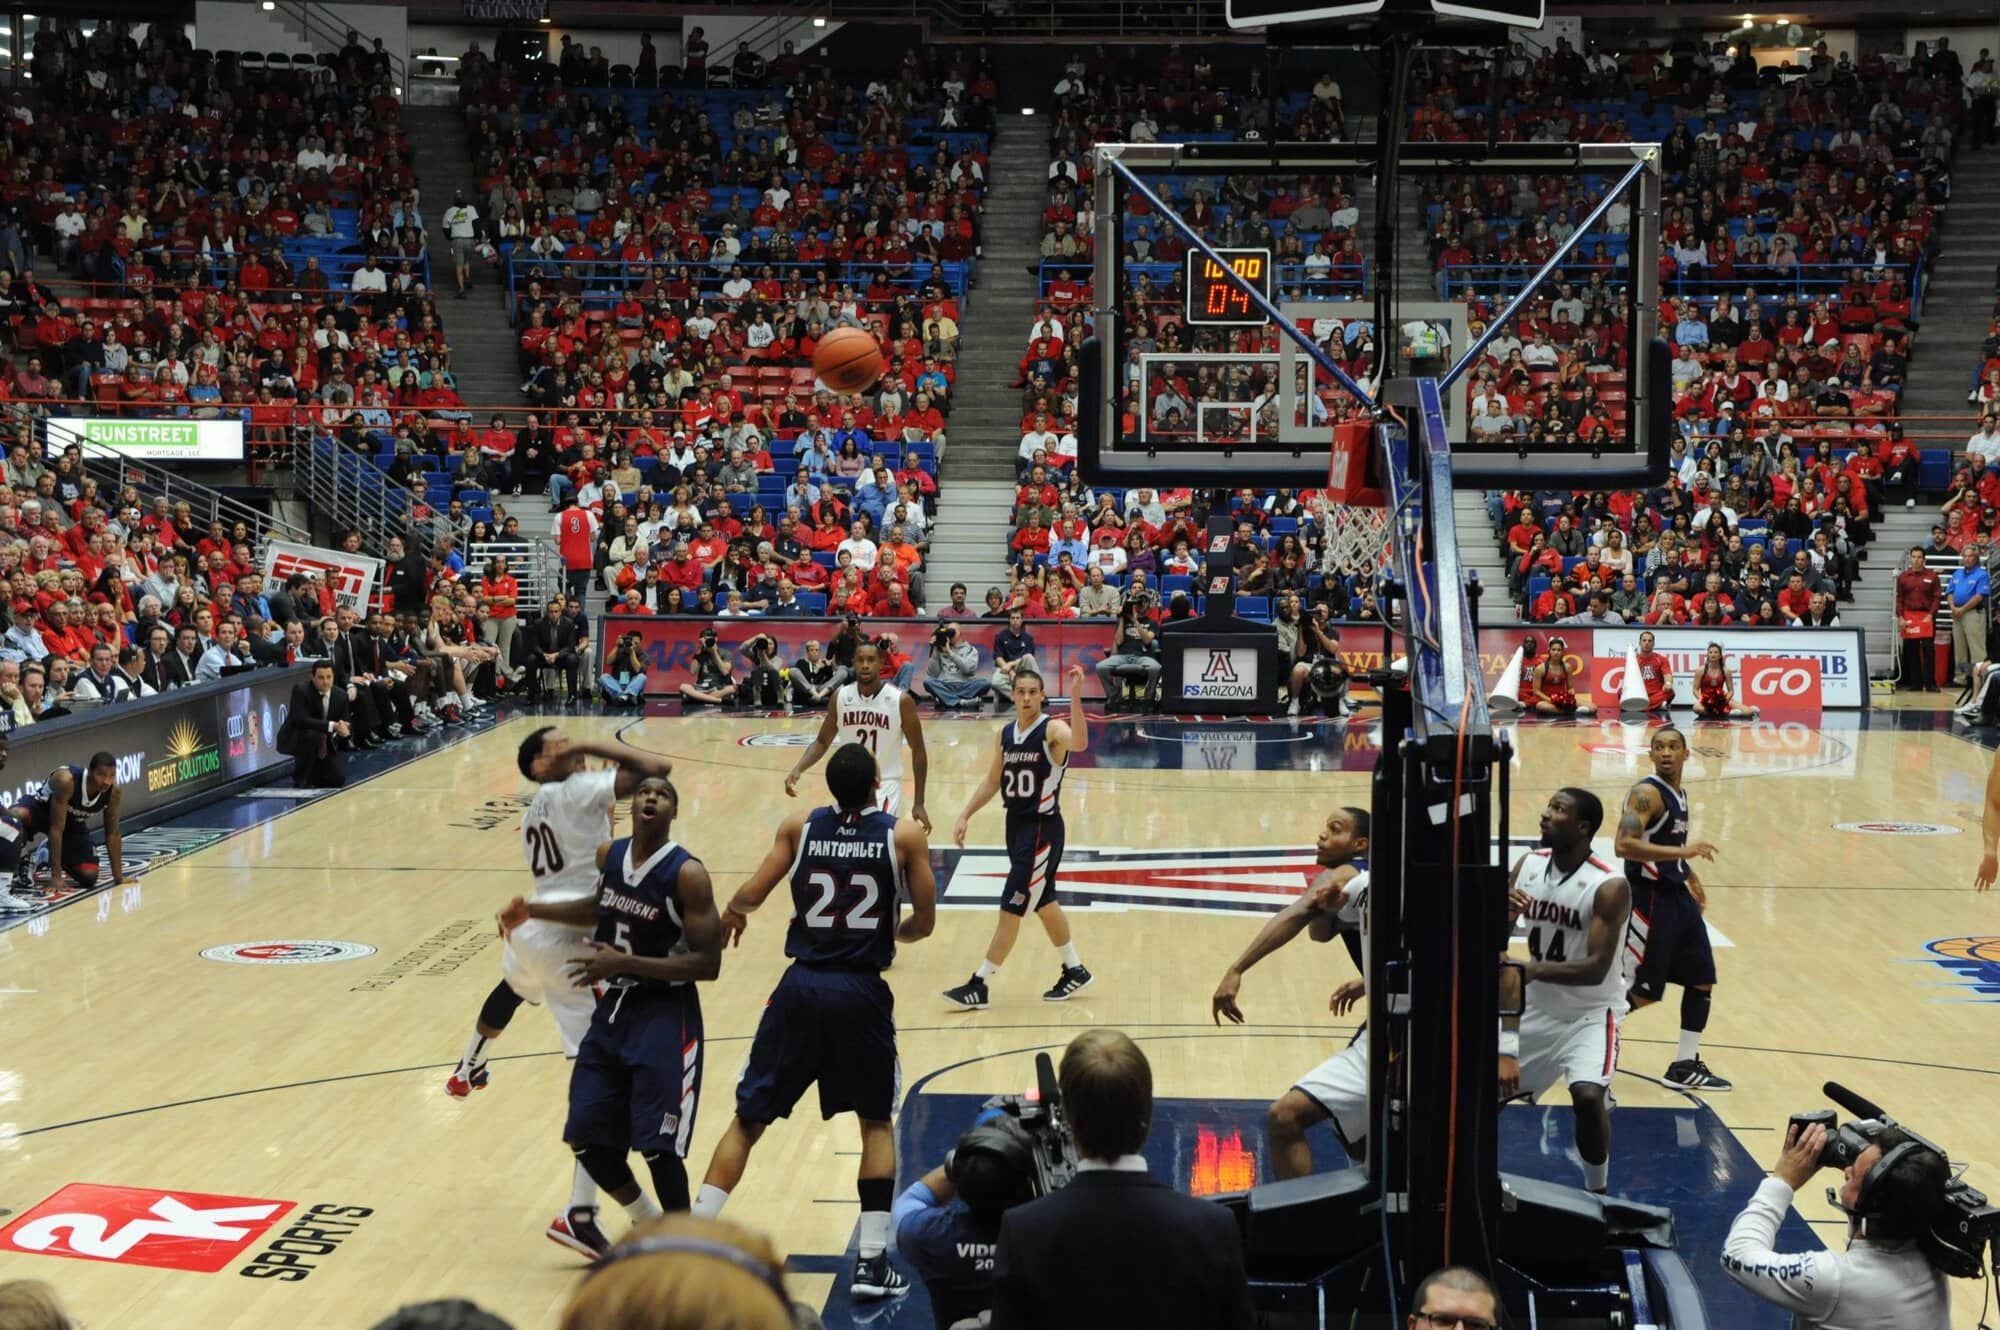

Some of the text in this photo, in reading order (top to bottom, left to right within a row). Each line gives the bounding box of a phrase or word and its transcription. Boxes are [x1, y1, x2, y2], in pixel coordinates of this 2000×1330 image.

[91, 427, 193, 442] SUNSTREET
[571, 518, 581, 533] 3
[336, 594, 358, 607] SPORTS
[1751, 667, 1811, 696] GO
[843, 710, 890, 730] ARIZONA
[148, 750, 220, 792] BRIGHT SOLUTIONS
[1004, 770, 1035, 797] 20
[526, 822, 564, 877] 20
[808, 840, 884, 859] PANTOPHLET
[805, 872, 880, 930] 22
[615, 921, 633, 957] 5
[12, 1195, 281, 1259] 2K
[239, 1203, 375, 1282] SPORTS
